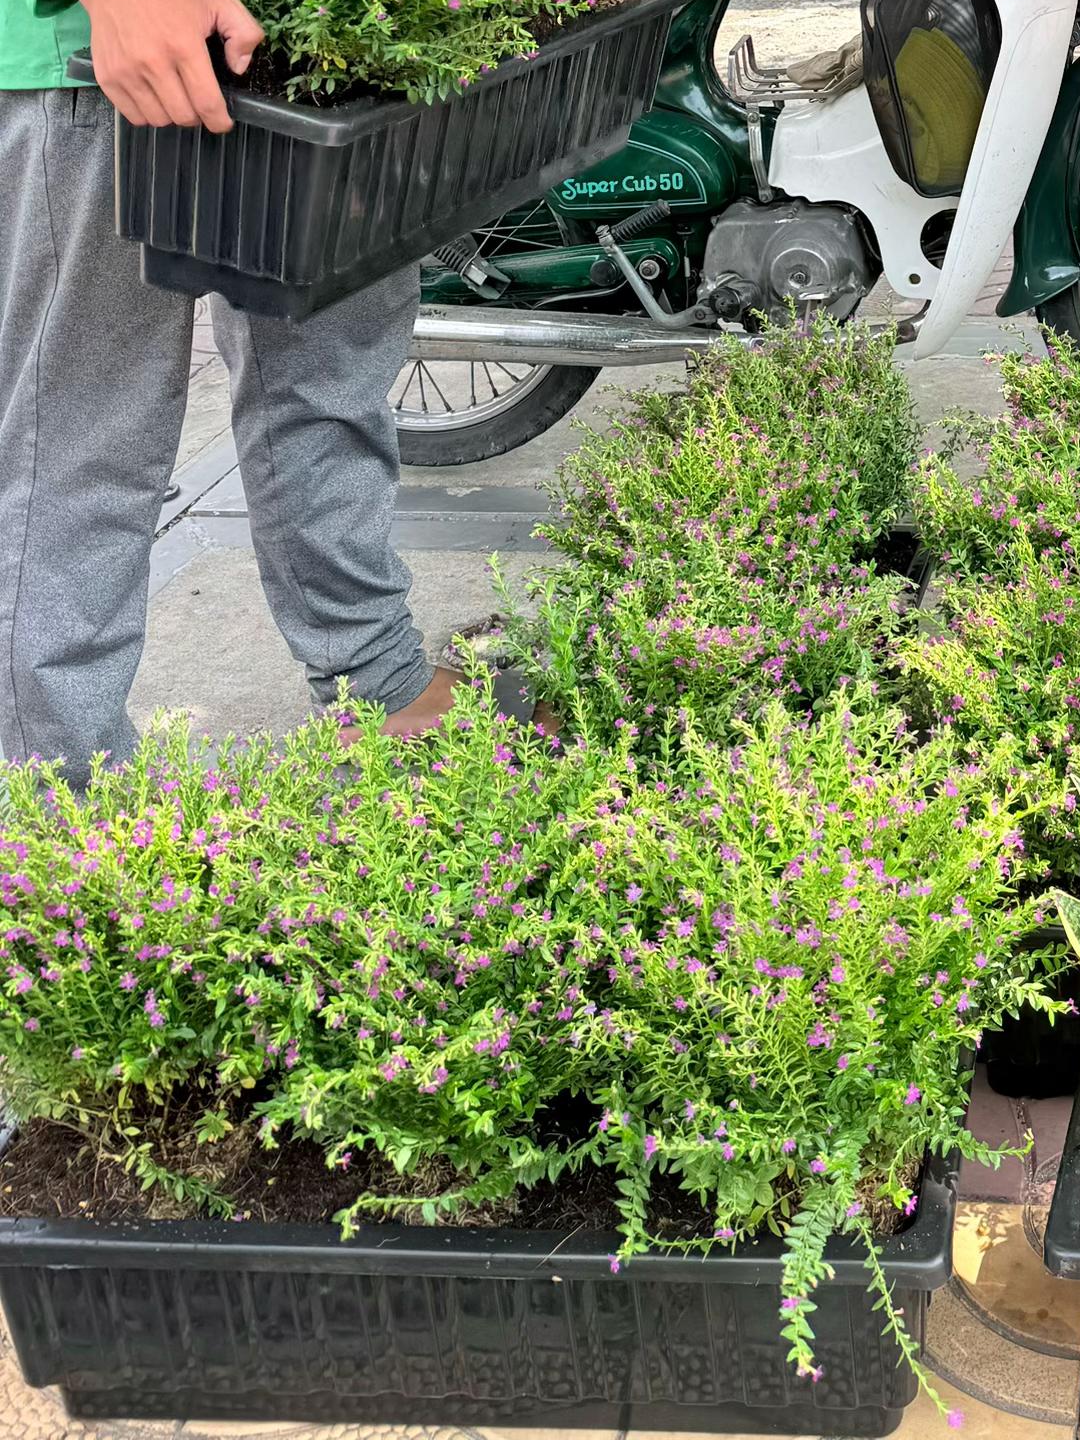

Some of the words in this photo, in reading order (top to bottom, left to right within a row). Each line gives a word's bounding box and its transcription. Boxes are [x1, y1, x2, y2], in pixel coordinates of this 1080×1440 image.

[562, 178, 619, 200] Super
[622, 175, 657, 192] Cub
[660, 172, 684, 191] 50
